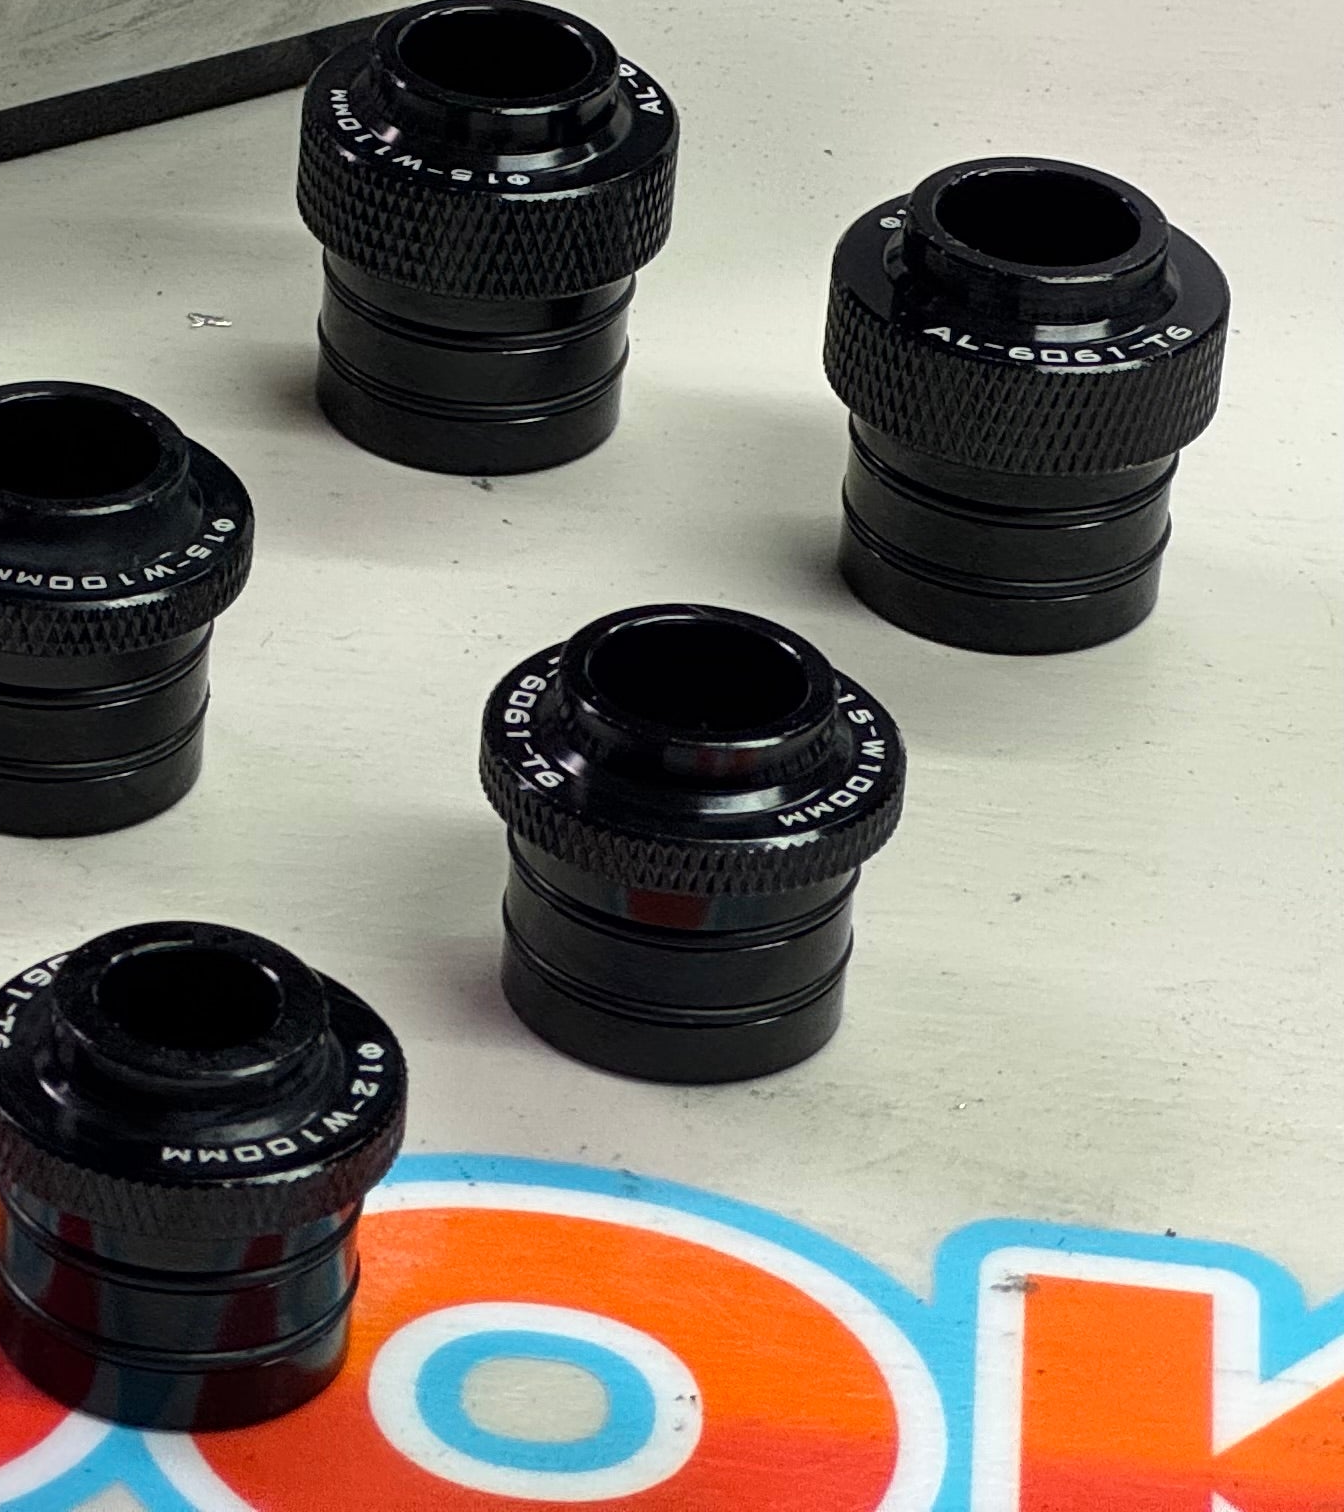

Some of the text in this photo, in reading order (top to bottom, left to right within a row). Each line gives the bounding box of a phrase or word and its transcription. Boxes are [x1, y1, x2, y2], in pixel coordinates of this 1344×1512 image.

[923, 324, 1193, 363] AL-6061-T6
[503, 655, 565, 789] -6061-T6
[777, 692, 886, 827] 15-W100MM
